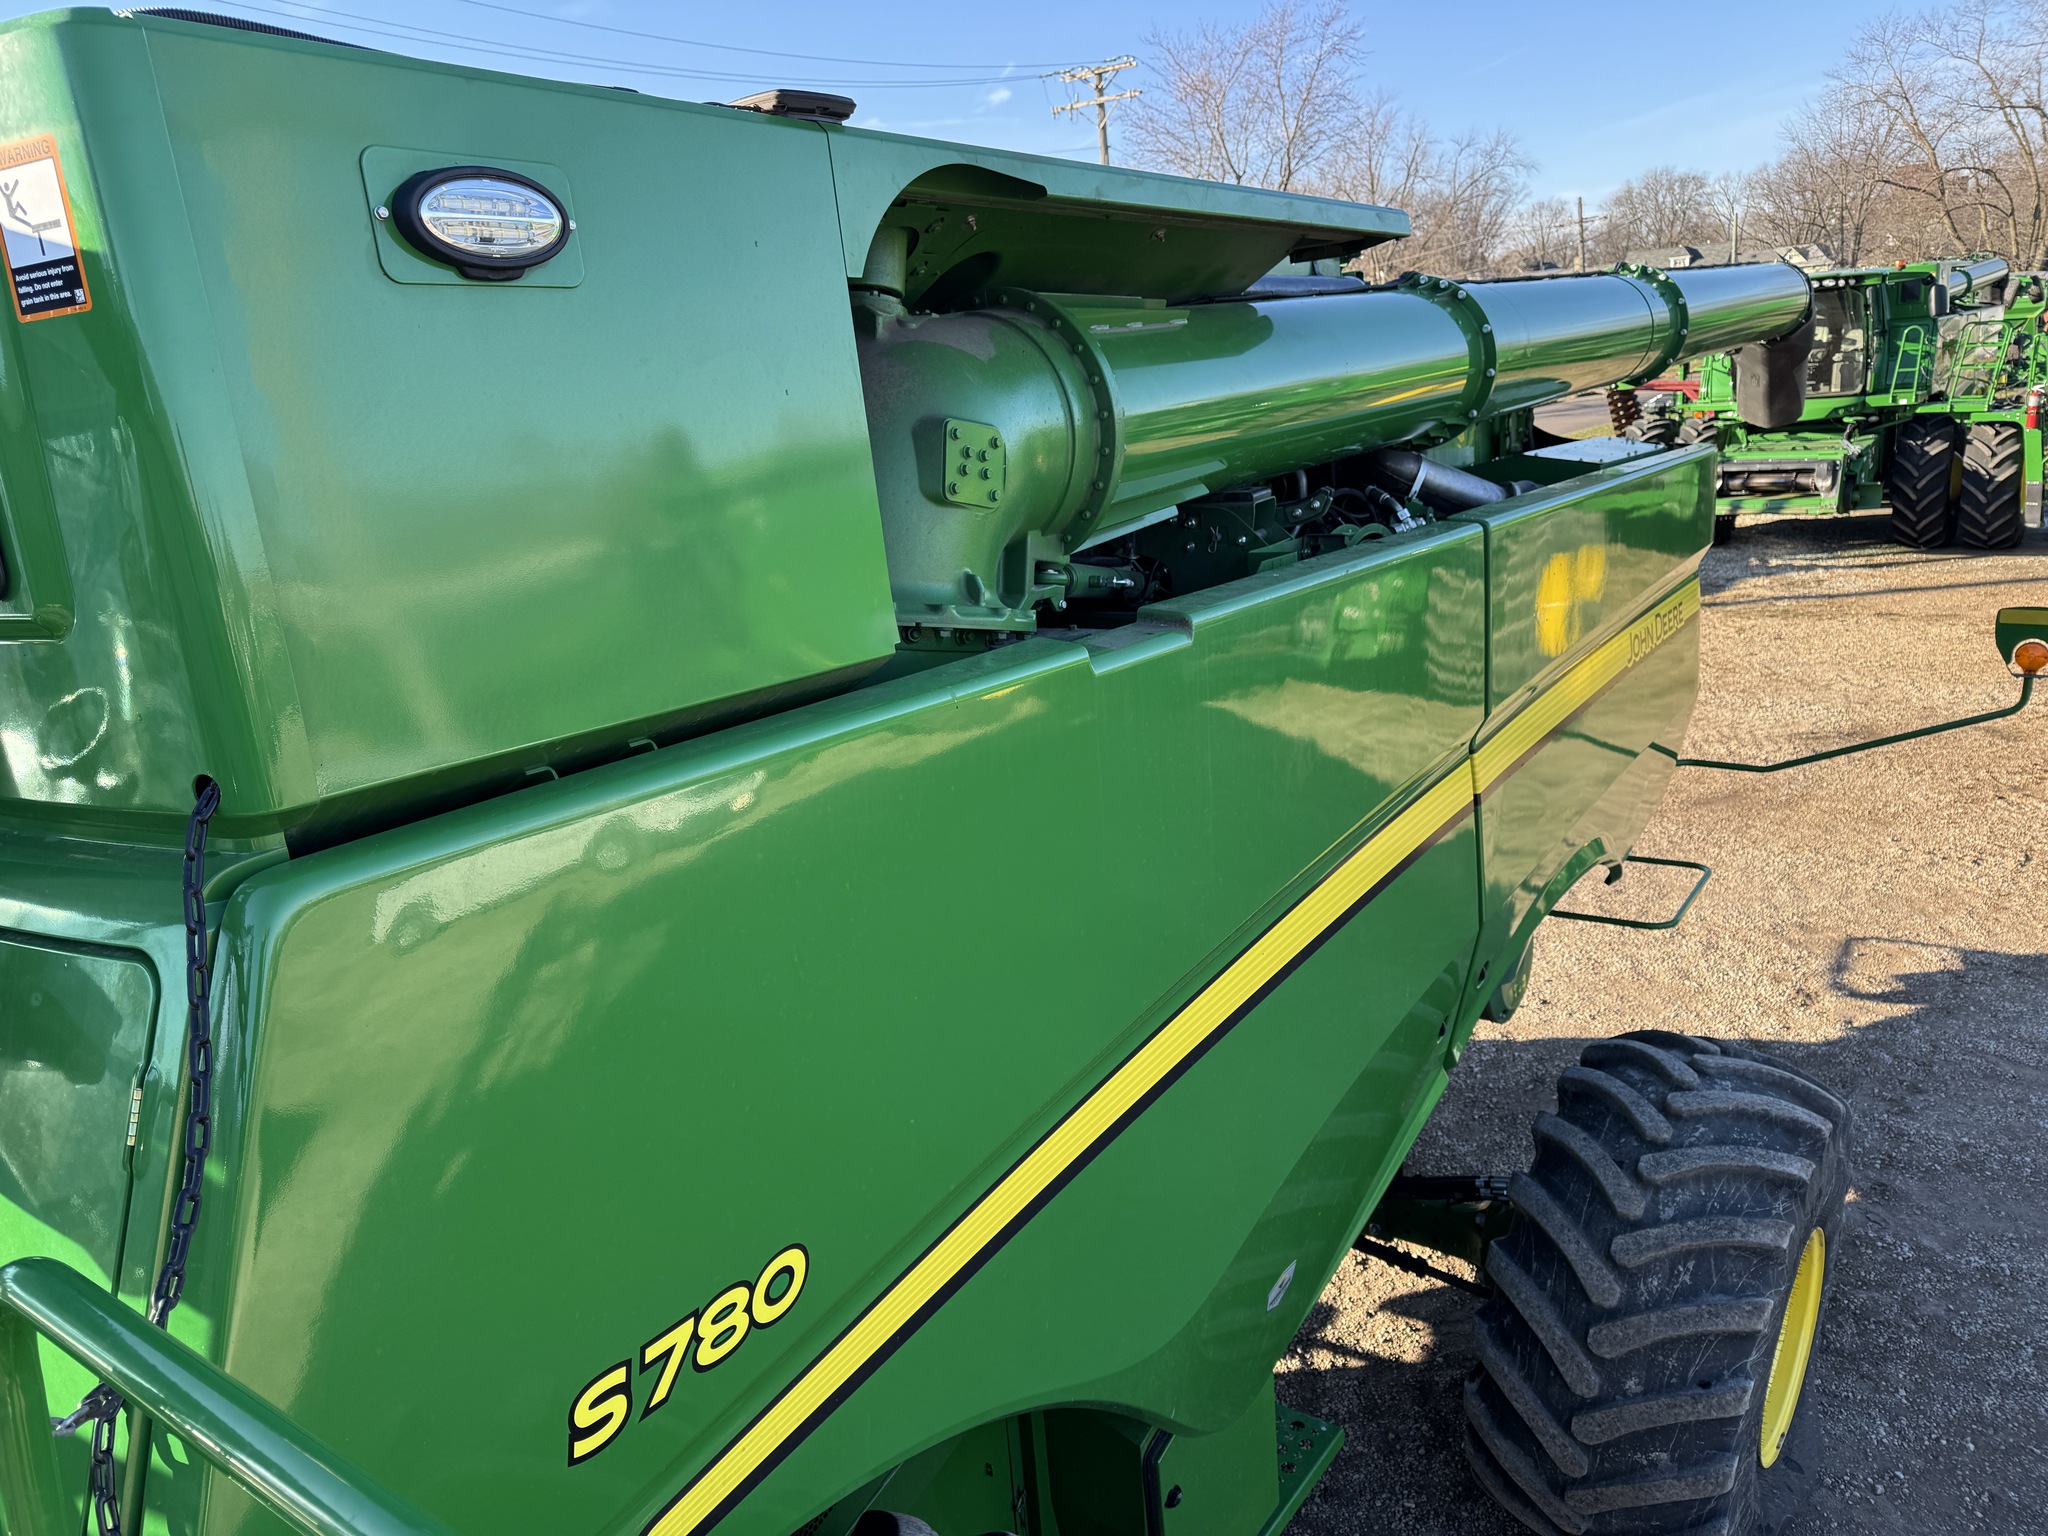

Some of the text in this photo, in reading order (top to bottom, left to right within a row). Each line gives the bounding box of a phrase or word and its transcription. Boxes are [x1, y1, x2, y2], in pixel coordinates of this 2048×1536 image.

[15, 264, 75, 282] Avoid serious injury from
[17, 279, 64, 294] falling. Do not enter
[20, 290, 72, 308] grain tank in this area.
[1627, 601, 1684, 666] JOHN DEERE
